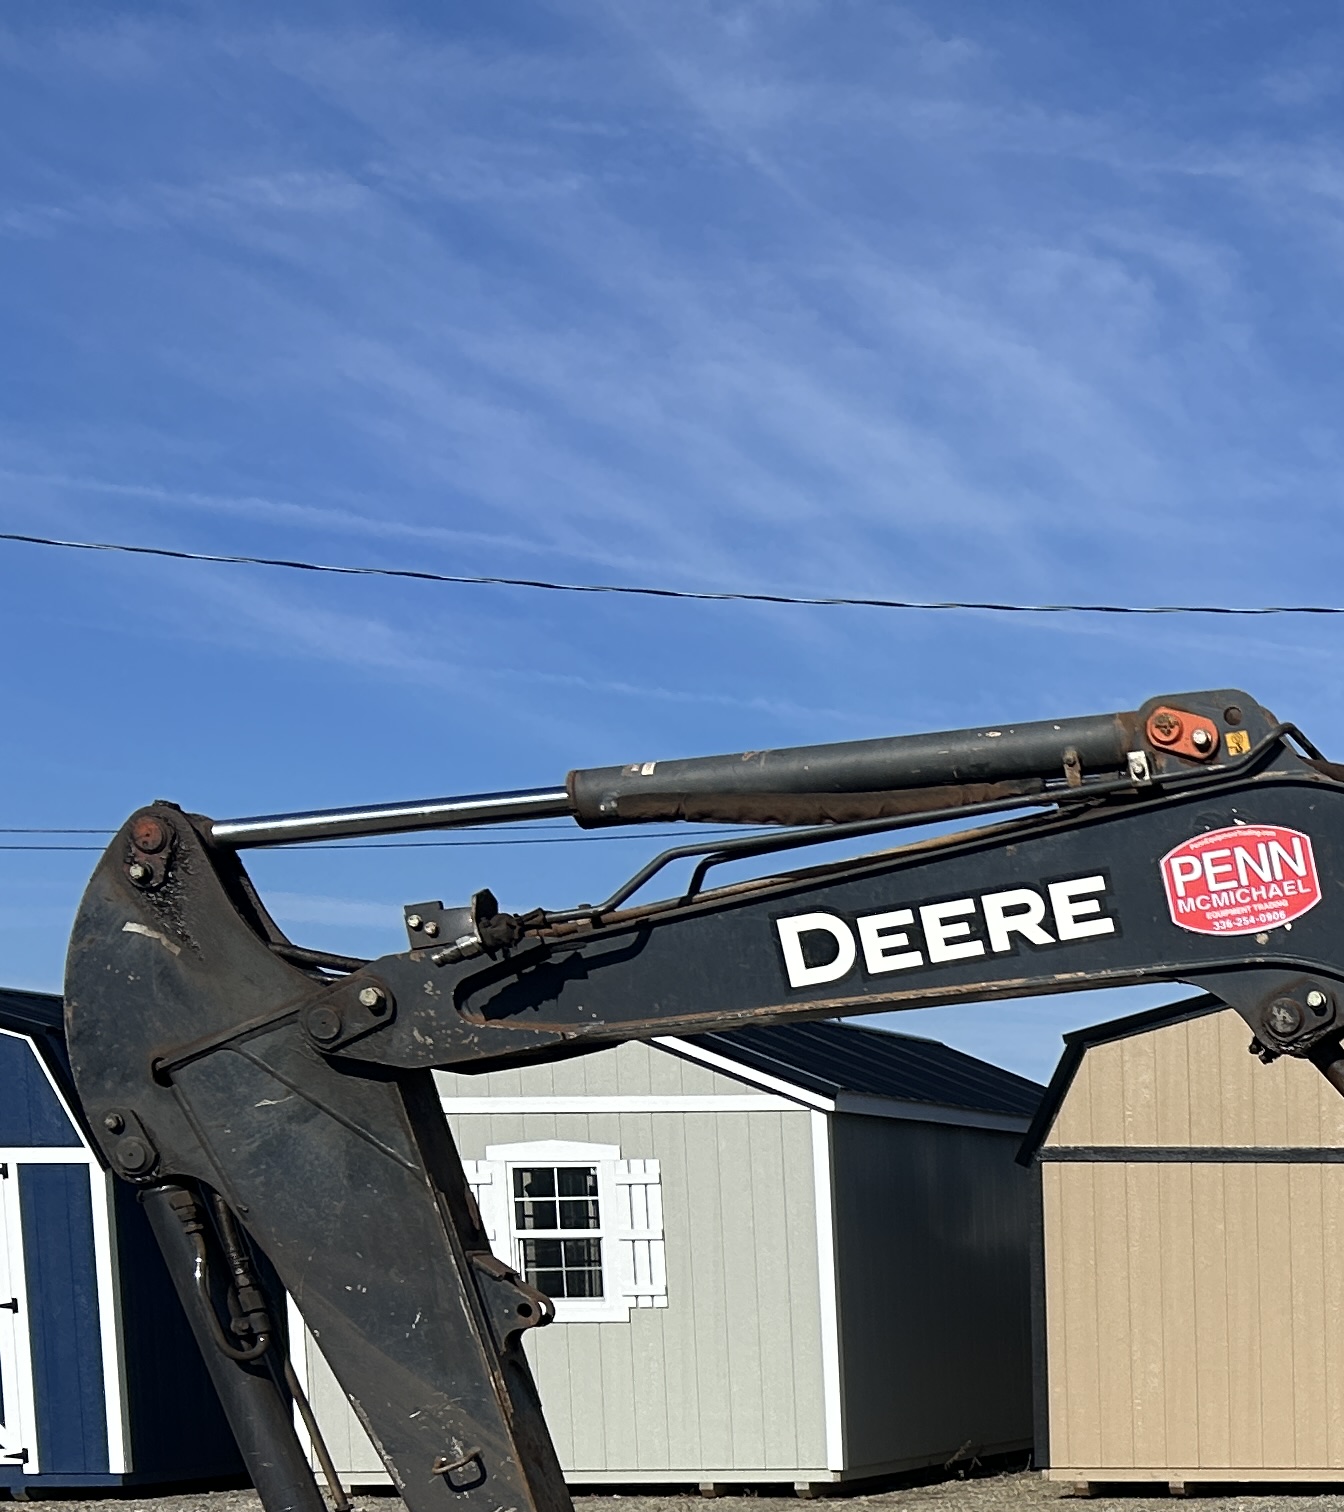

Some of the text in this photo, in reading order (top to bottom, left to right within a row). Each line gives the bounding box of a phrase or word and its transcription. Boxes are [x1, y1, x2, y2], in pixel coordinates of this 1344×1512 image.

[1169, 836, 1308, 897] PENN
[1177, 879, 1312, 914] MCMICHAEL
[1206, 898, 1289, 920] EQUIPMENT TRADING
[776, 875, 1115, 988] DEERE
